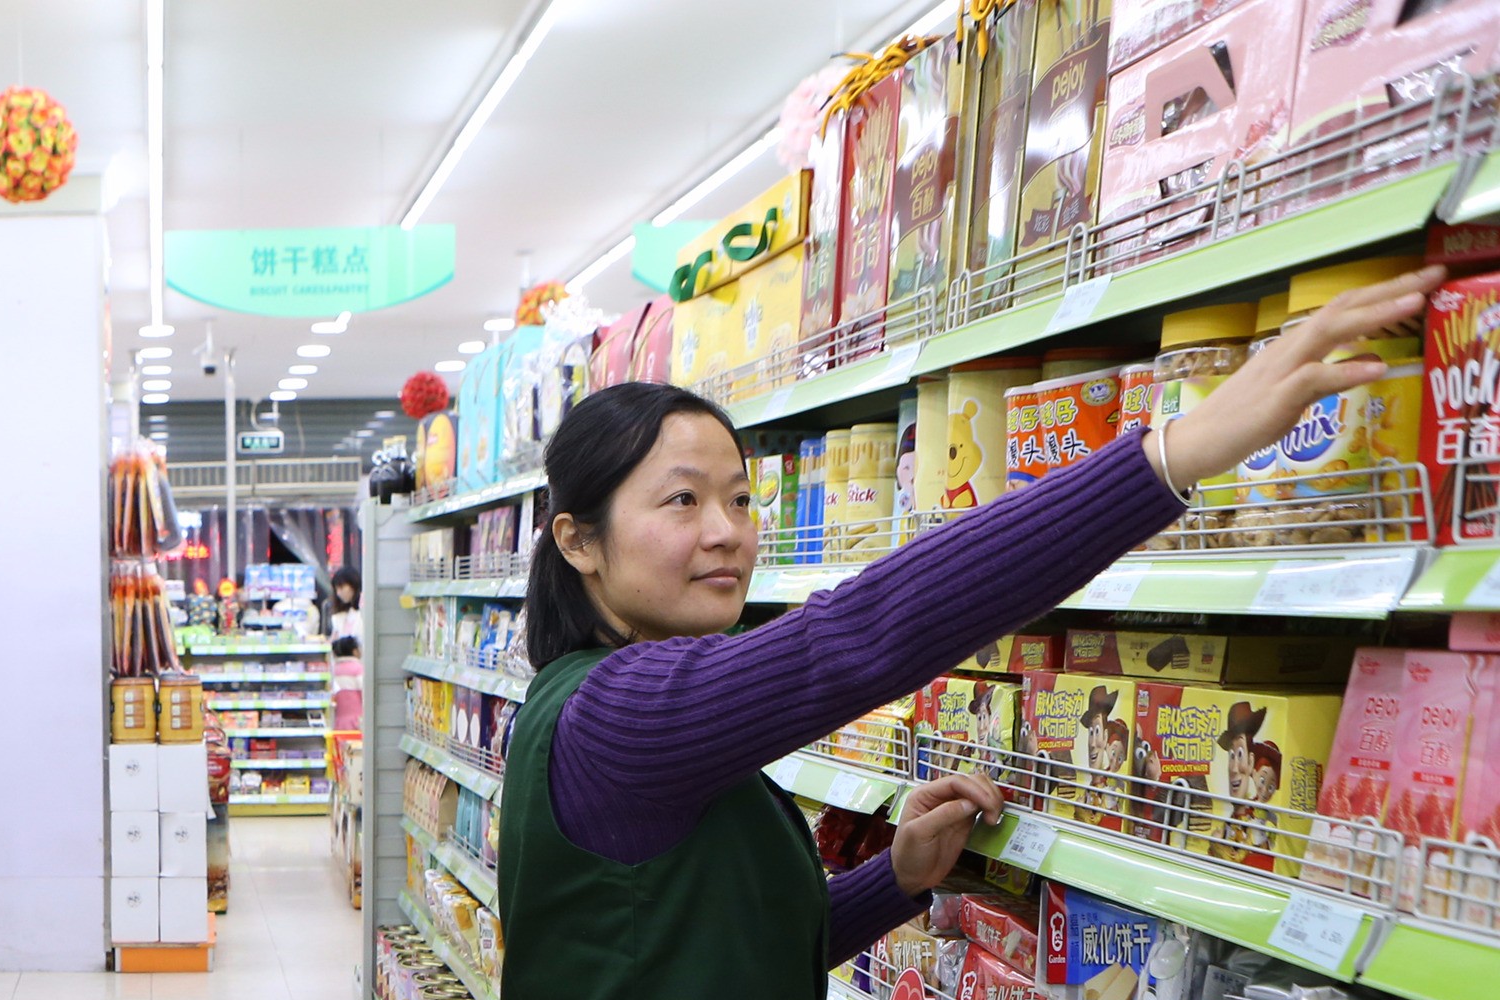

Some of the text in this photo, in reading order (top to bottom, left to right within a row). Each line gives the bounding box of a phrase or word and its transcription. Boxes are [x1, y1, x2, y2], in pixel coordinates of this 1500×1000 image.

[1051, 58, 1087, 107] pejoy
[251, 245, 369, 276] 饼干糕点
[250, 285, 288, 297] BISCUIT
[1436, 413, 1500, 465] 百奇
[1035, 689, 1084, 718] 威化巧克力
[1157, 705, 1221, 741] 威化巧克力
[1038, 740, 1074, 750] CHOCOLATE WAFER
[1161, 764, 1209, 775] CHOCOLATE WAFER
[1082, 922, 1150, 966] 威化饼干
[1049, 955, 1066, 964] Garden
